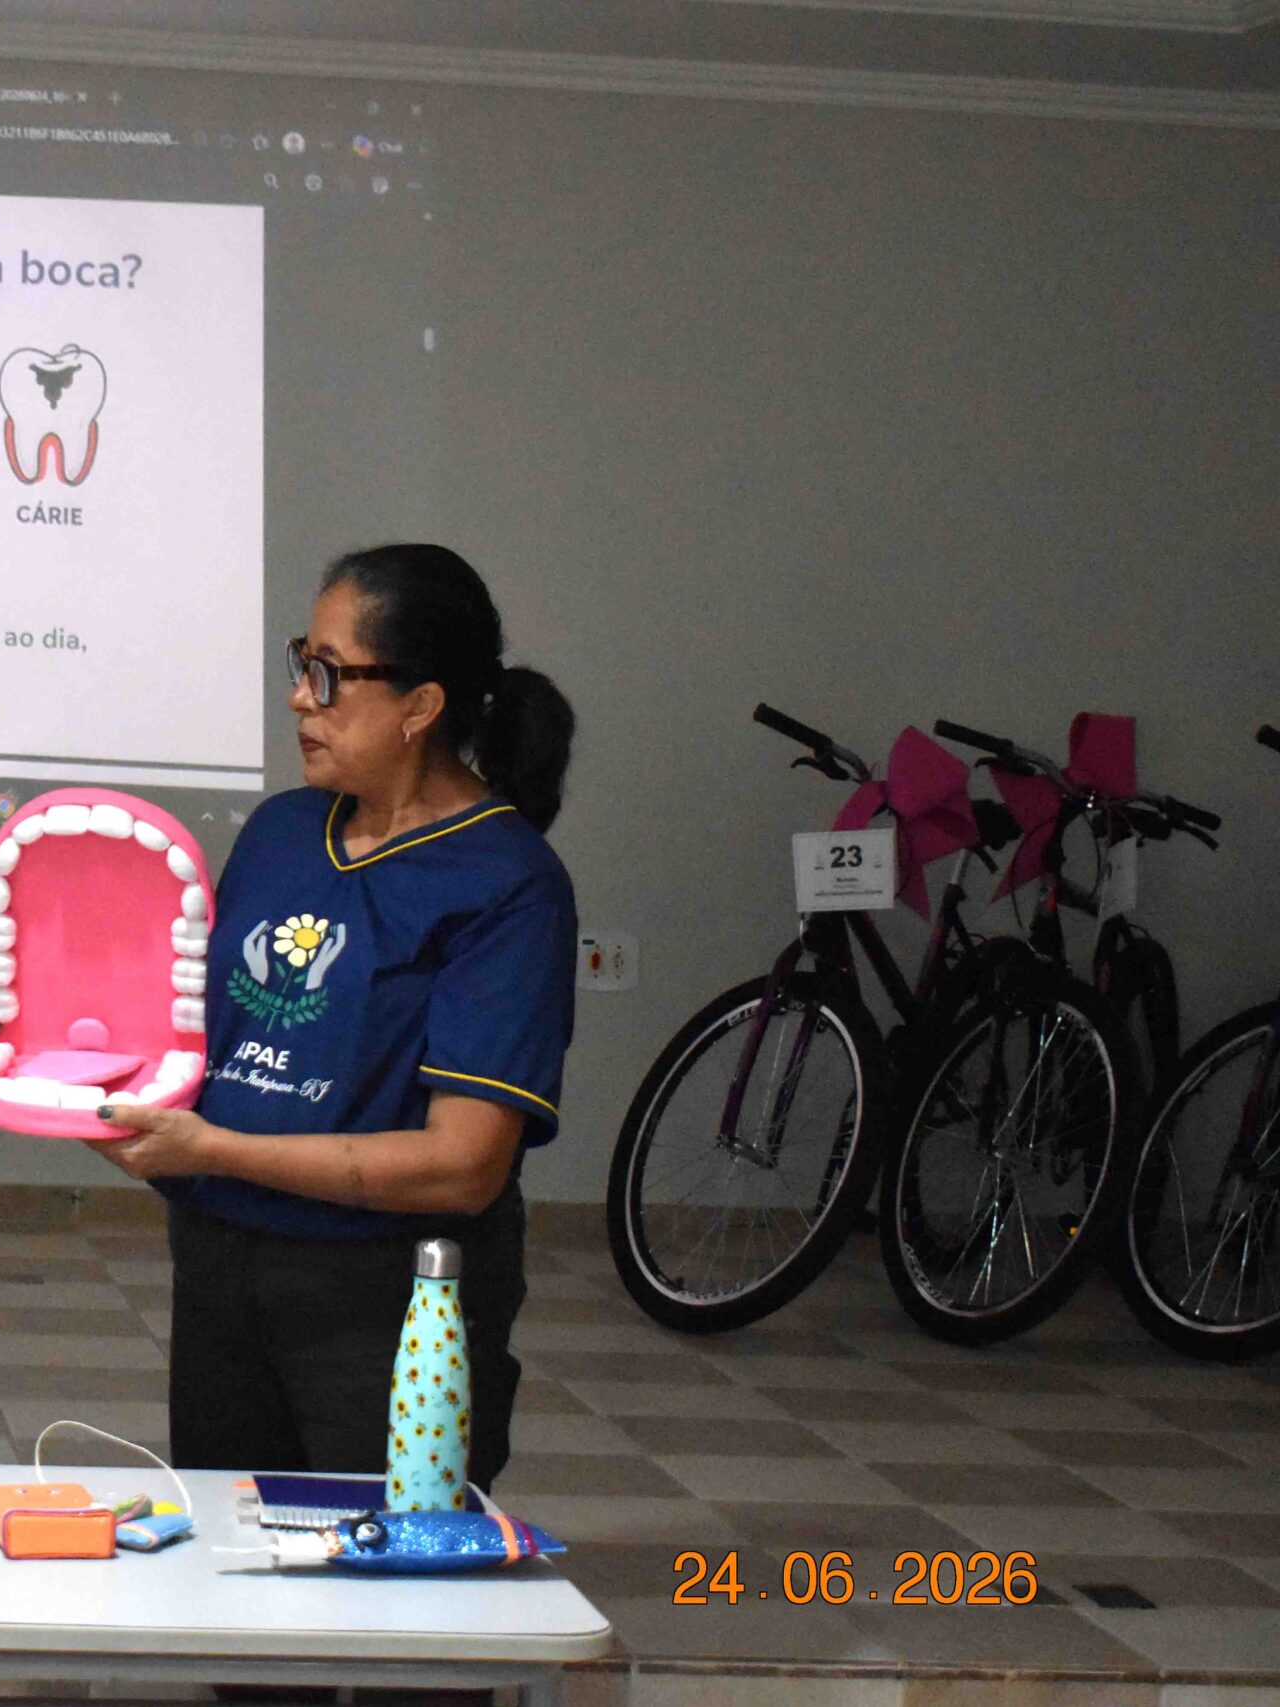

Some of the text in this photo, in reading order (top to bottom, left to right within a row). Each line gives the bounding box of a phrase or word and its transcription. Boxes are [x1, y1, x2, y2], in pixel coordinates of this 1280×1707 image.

[21, 249, 143, 289] boca?
[16, 500, 83, 526] CÁRIE
[4, 630, 35, 648] ao
[42, 626, 88, 653] dia,
[830, 845, 863, 868] 23
[234, 1040, 291, 1070] APAE
